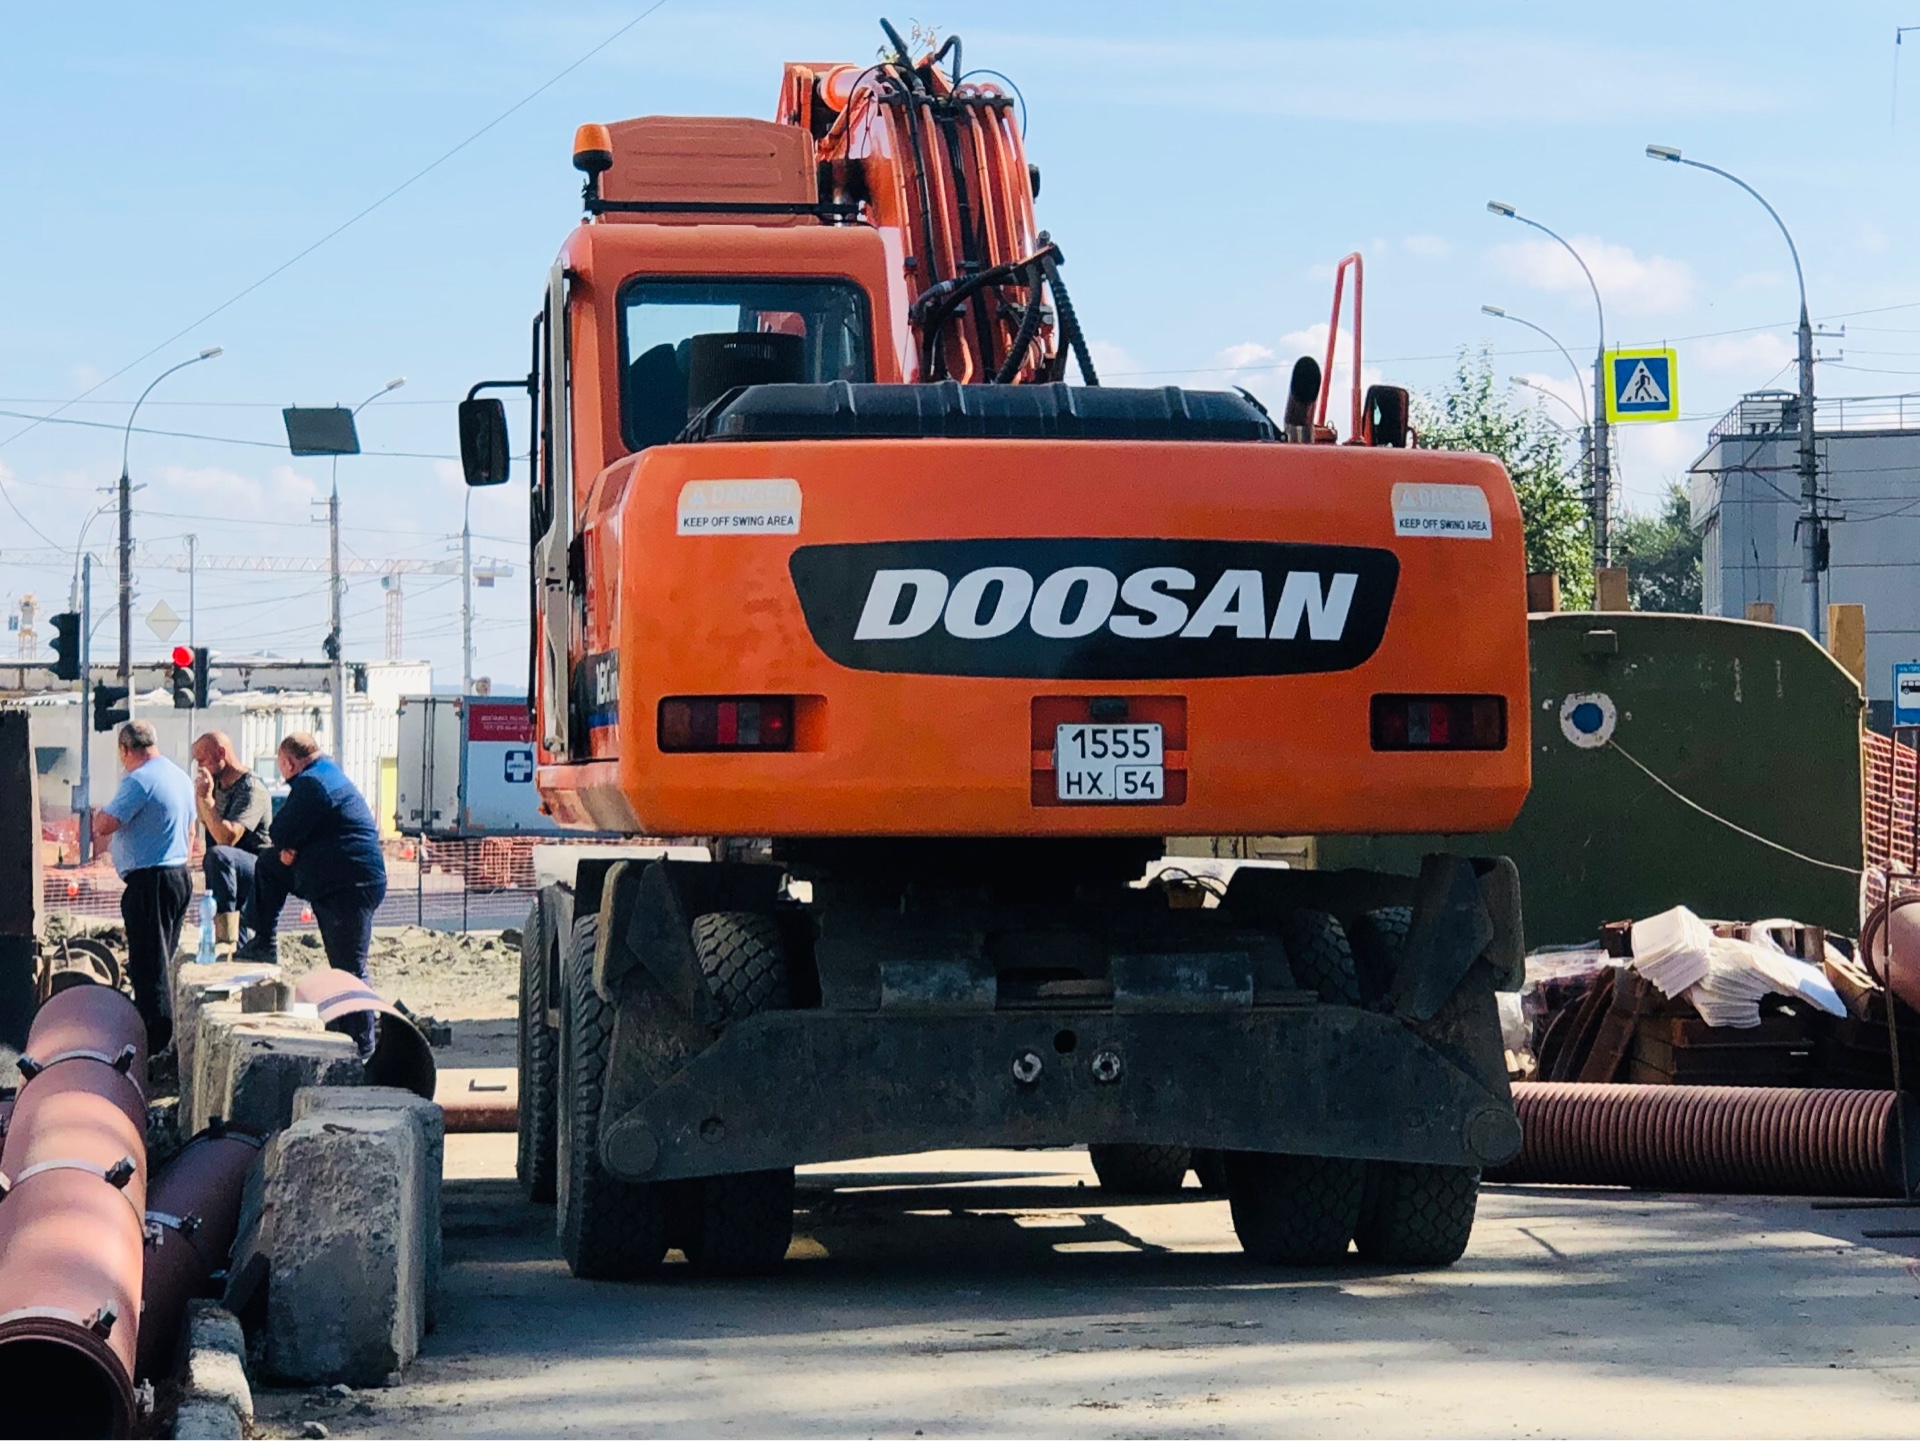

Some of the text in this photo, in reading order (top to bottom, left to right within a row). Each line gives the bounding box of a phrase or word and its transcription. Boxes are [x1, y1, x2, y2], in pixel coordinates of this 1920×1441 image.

[712, 485, 792, 504] DANGER
[683, 515, 794, 527] KEEP OFF SWING AREA
[1399, 518, 1487, 531] KEEP OFF SWING AREA
[854, 566, 1359, 641] DOOSAN
[1071, 728, 1150, 759] 1555
[1124, 771, 1155, 795] 54
